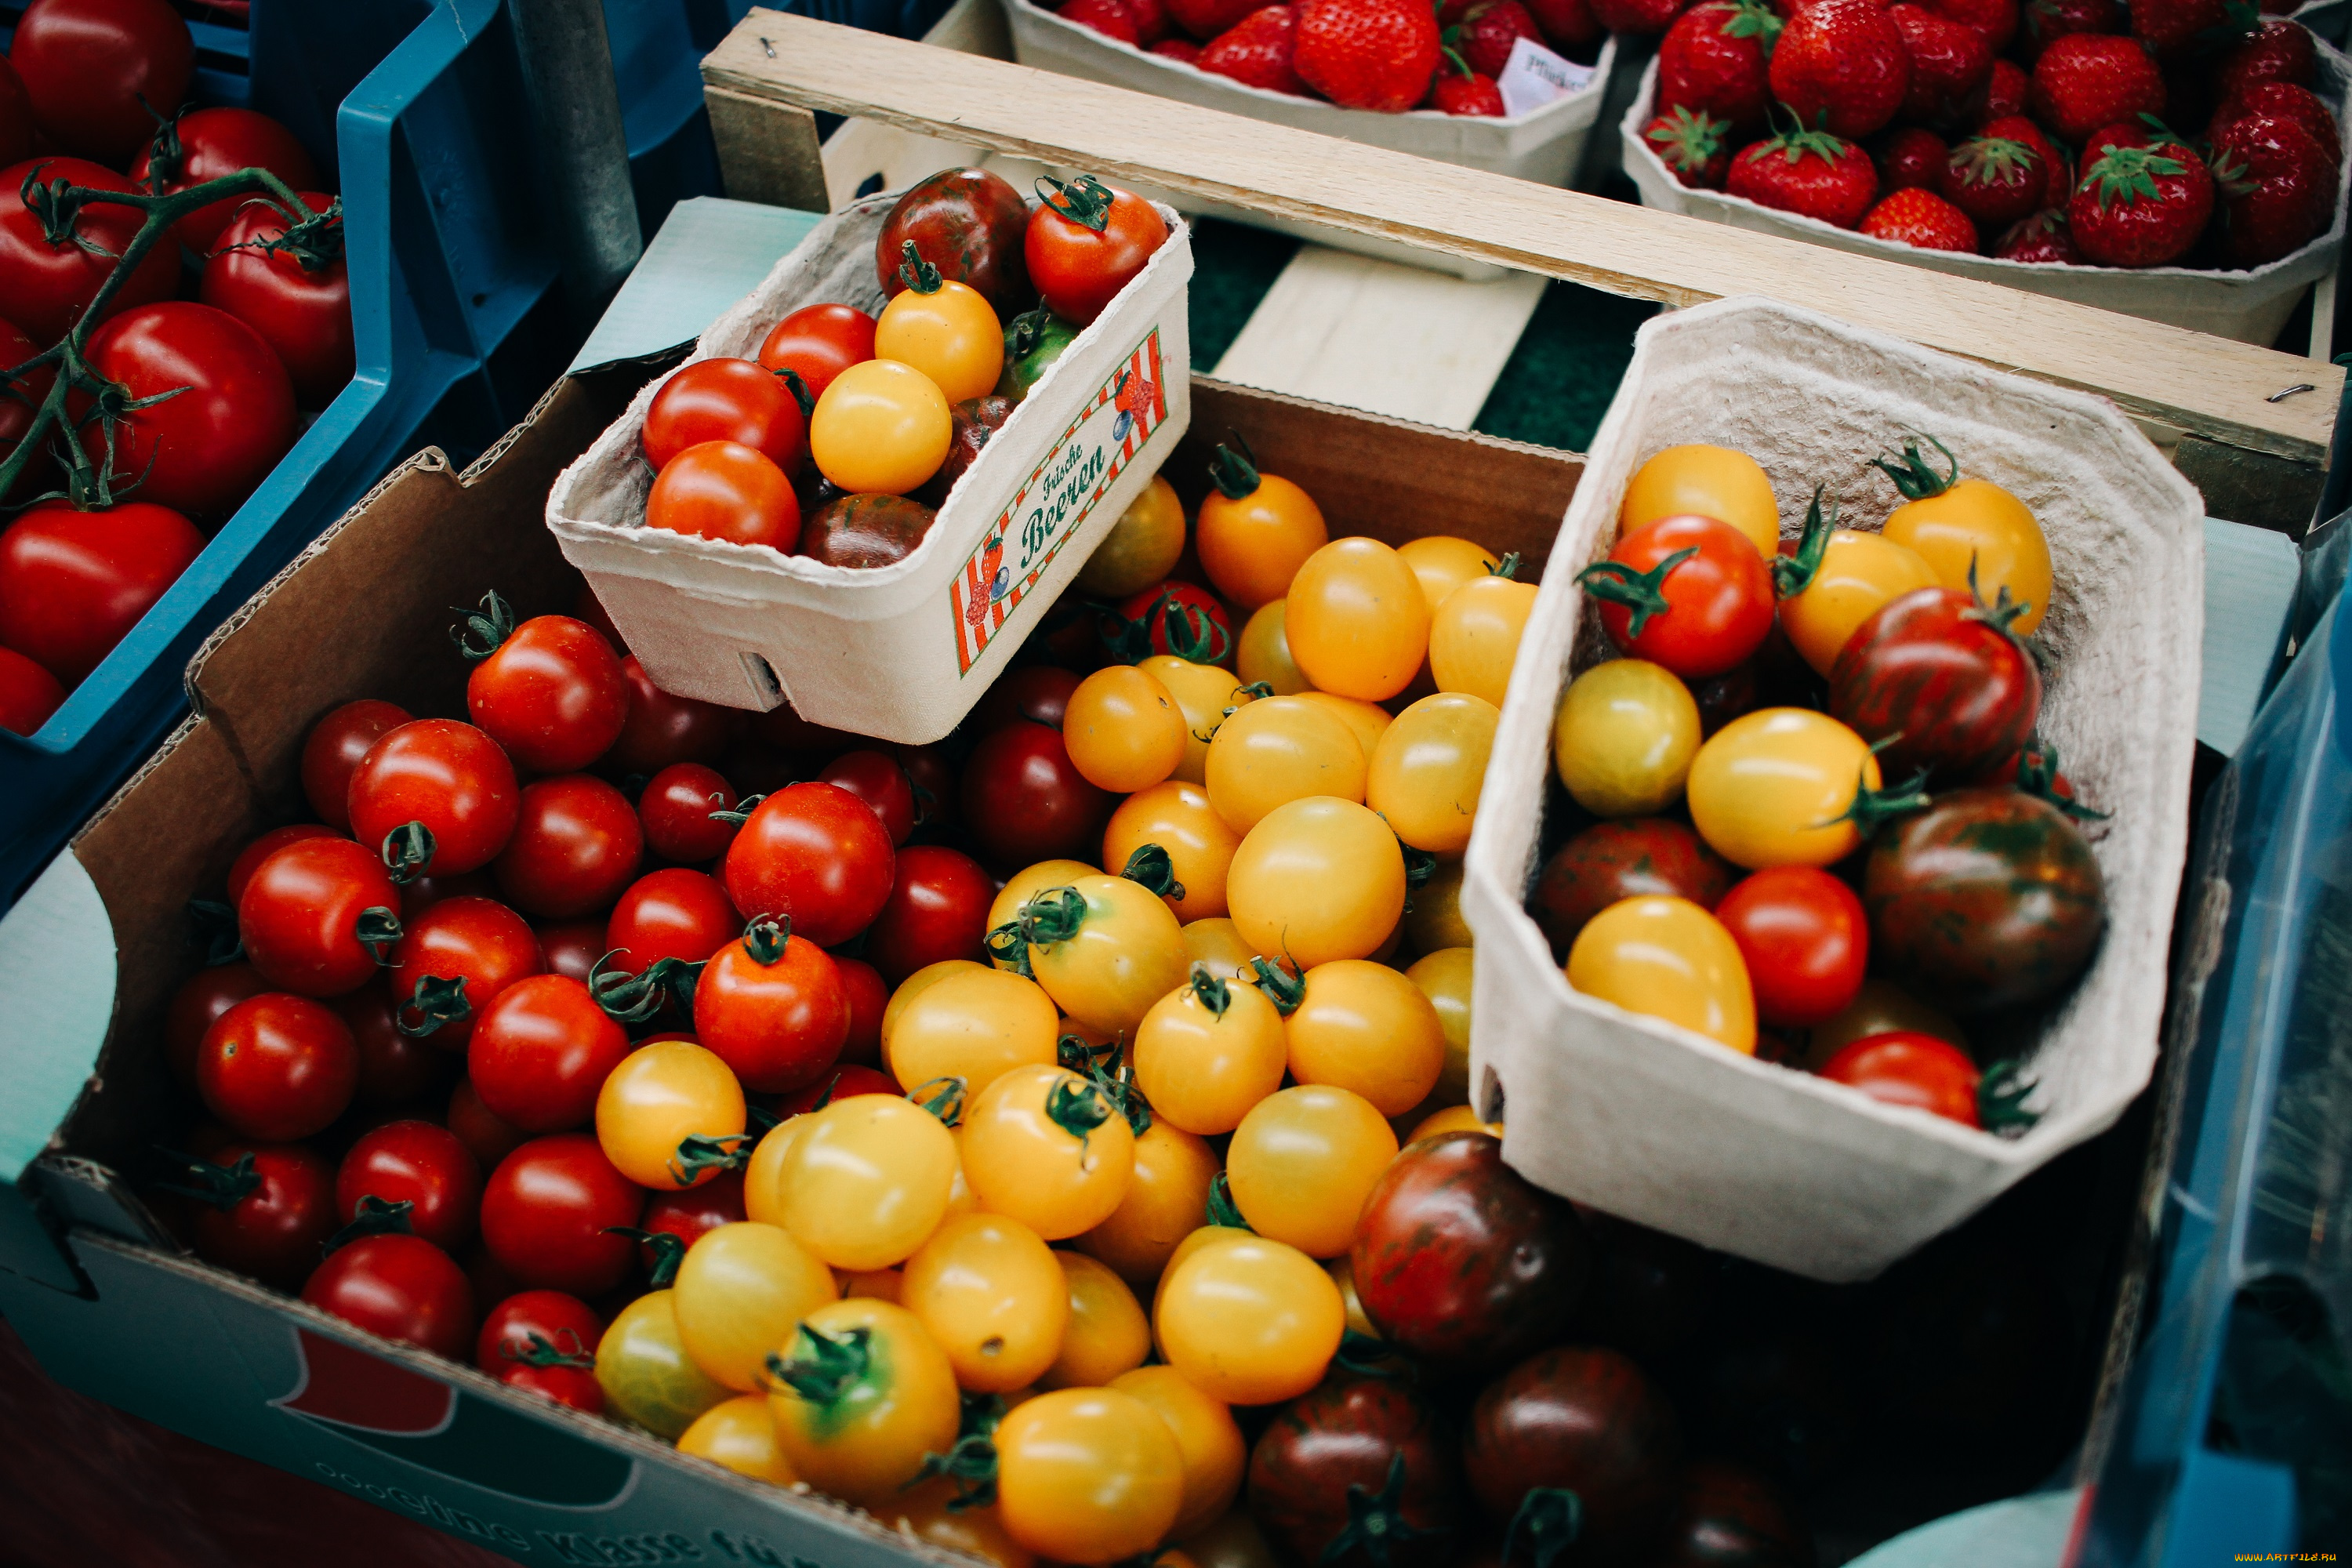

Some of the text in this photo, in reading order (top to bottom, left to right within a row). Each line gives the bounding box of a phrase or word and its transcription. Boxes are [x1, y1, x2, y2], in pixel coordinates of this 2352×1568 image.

[1044, 445, 1083, 501] Frische
[1021, 445, 1105, 568] Beeren
[536, 1530, 703, 1567] Klasse
